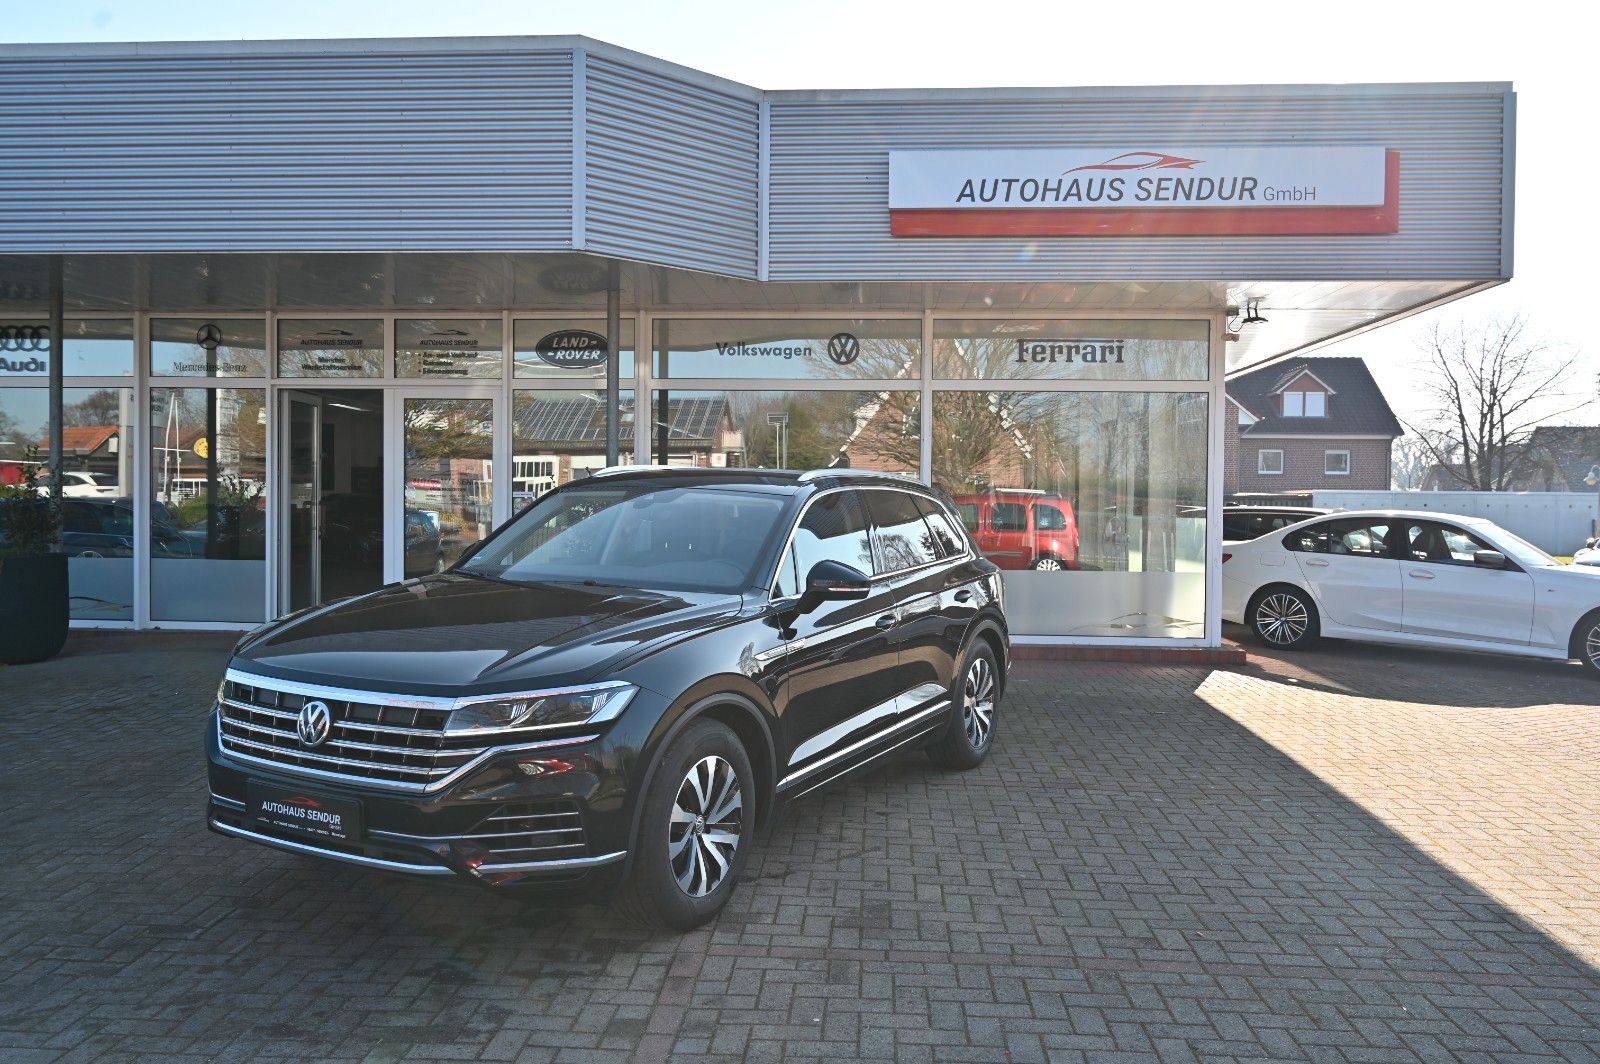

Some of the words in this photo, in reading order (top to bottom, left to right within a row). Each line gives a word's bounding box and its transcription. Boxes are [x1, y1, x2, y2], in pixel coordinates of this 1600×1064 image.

[956, 177, 1126, 203] AUTOHAUS
[1134, 176, 1258, 202] SENDUR
[1263, 186, 1317, 202] GmbH
[715, 341, 812, 360] Volkswagen
[1016, 338, 1124, 363] Ferrari
[0, 357, 47, 372] Audi
[173, 361, 247, 373] Mercedes-Benz
[262, 801, 306, 818] AUTOHAUS
[307, 809, 341, 825] SENDUR
